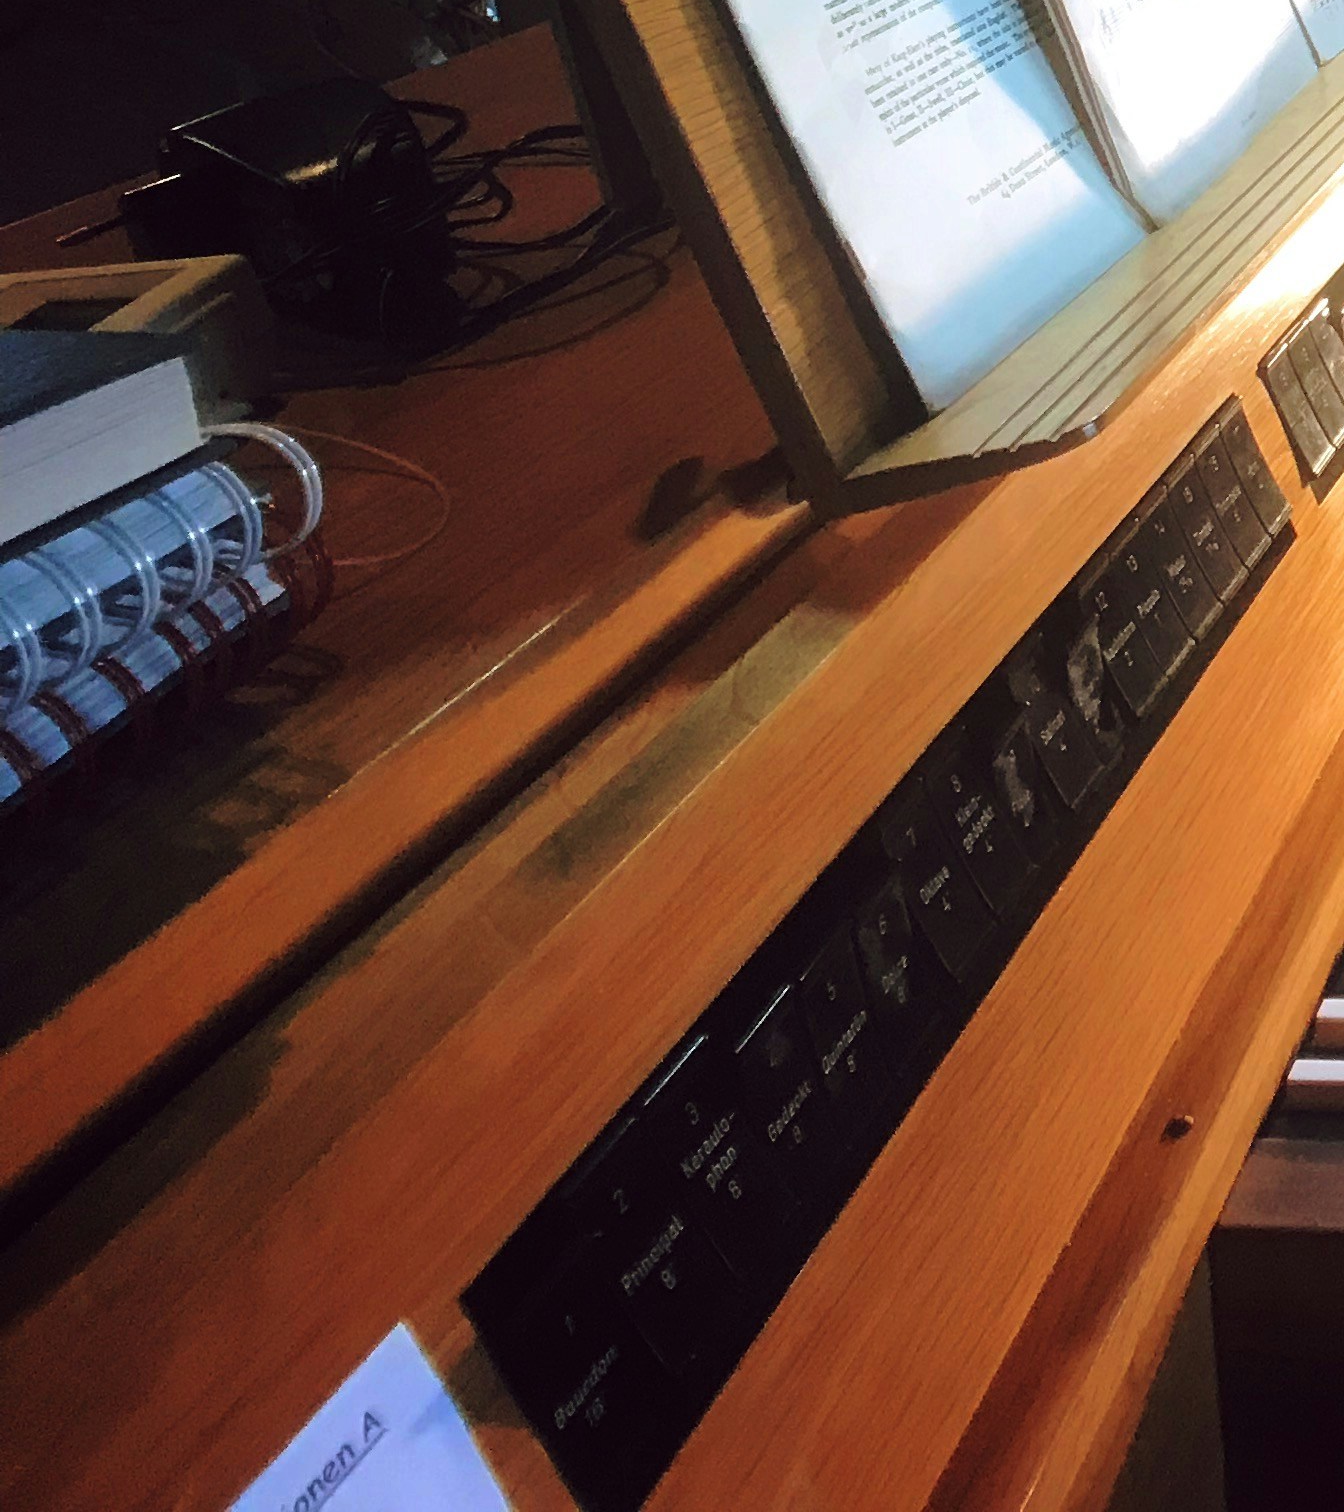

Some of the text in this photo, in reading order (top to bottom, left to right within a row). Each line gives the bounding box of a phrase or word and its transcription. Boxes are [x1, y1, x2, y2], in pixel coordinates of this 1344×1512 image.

[684, 1101, 700, 1125] 3
[613, 1188, 630, 1215] 2
[620, 1214, 687, 1297] Principal
[363, 1411, 382, 1443] A
